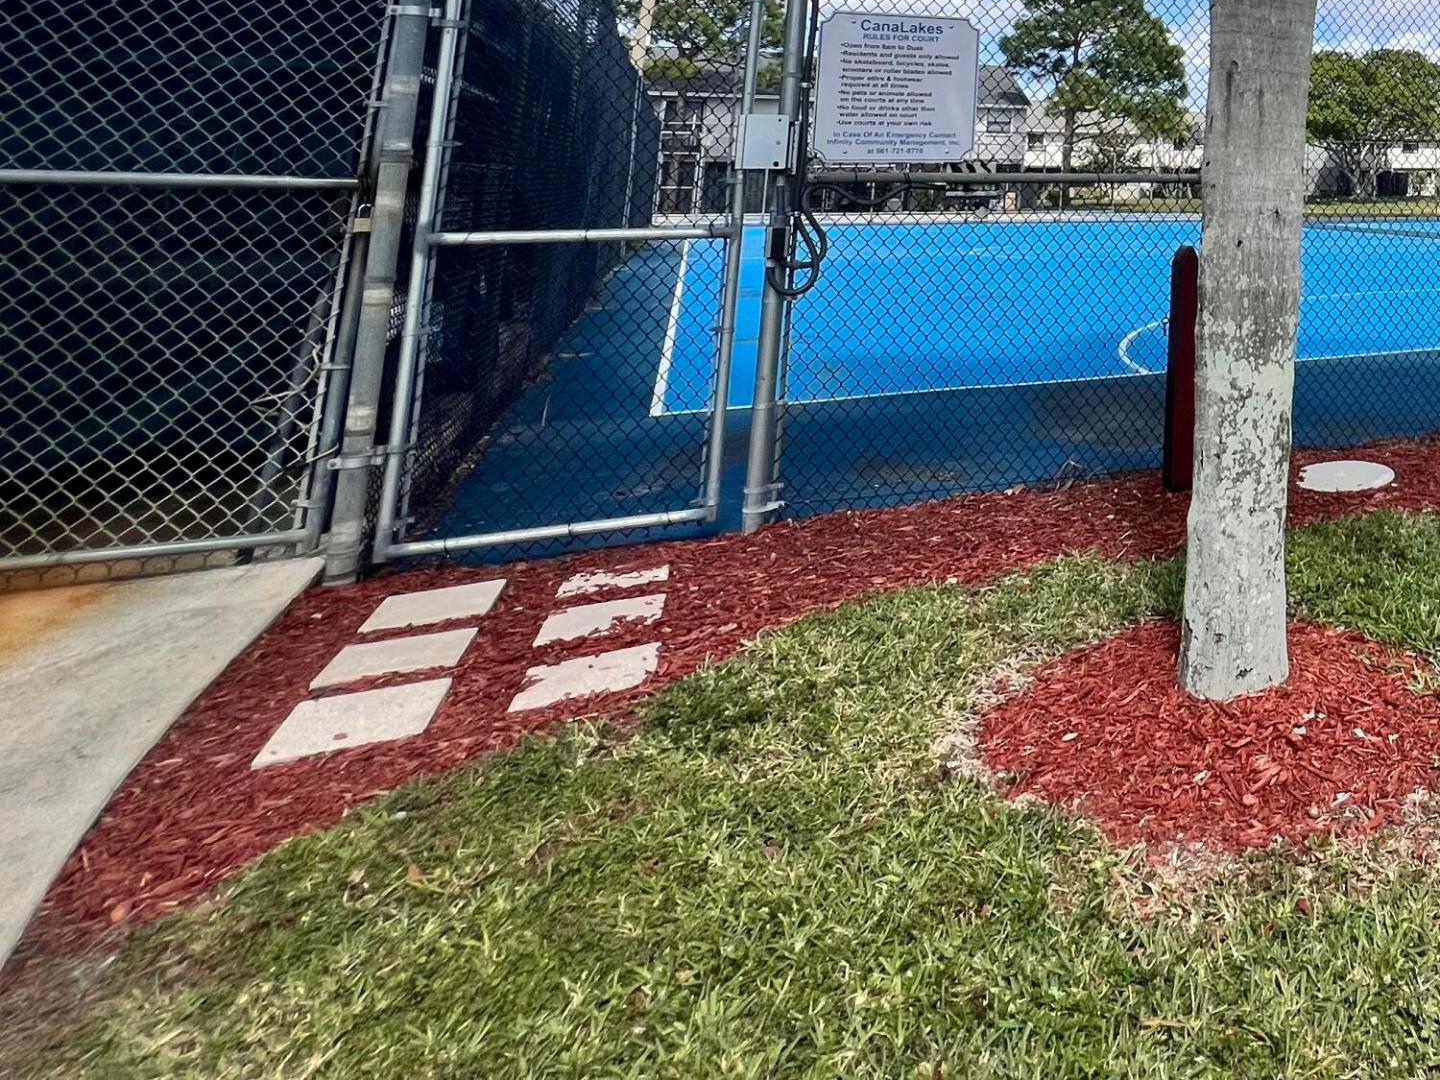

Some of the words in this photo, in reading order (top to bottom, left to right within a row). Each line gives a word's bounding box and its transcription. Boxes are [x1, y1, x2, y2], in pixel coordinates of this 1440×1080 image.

[860, 19, 944, 35] CanaLakes
[863, 33, 890, 41] RULES
[886, 131, 927, 139] Emergency
[827, 138, 852, 146] Infinity
[854, 138, 898, 146] Community
